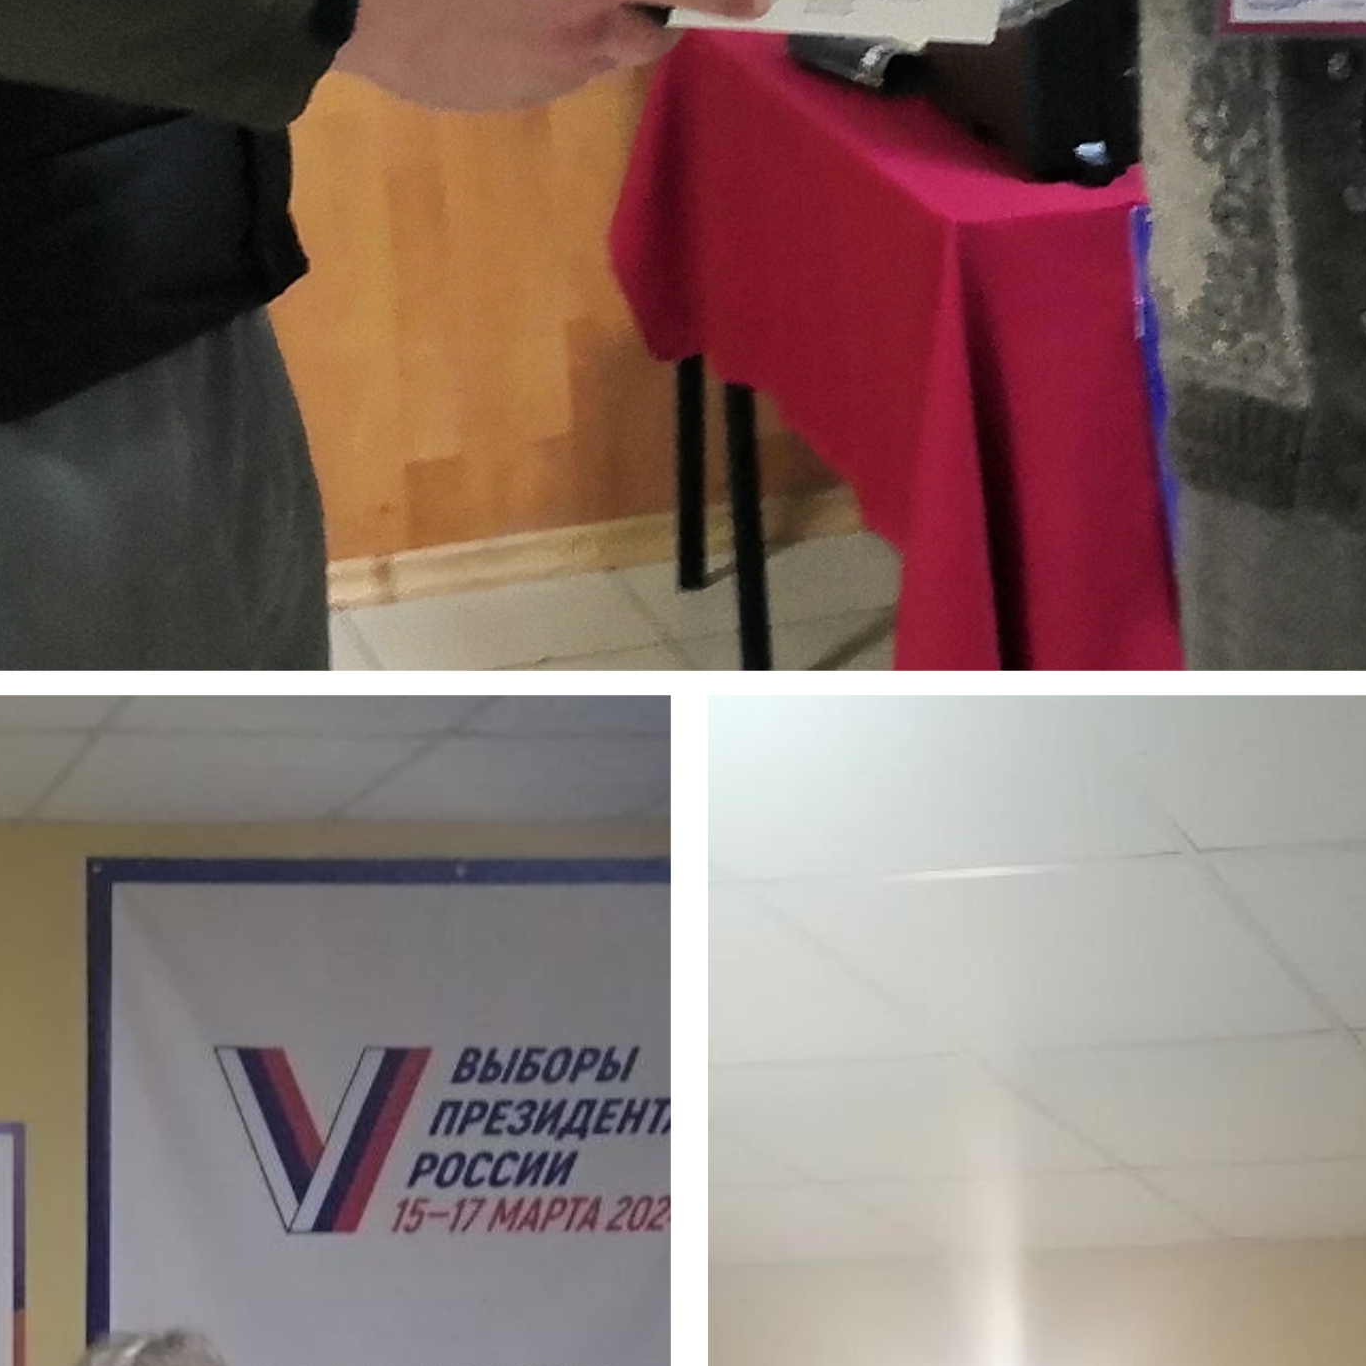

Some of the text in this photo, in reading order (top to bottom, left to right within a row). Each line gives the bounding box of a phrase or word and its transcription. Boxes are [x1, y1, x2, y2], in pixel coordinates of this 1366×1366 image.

[450, 1046, 640, 1084] ВЫБОРЫ
[406, 1151, 579, 1189] РОССИИ
[487, 1195, 602, 1233] МАРТА
